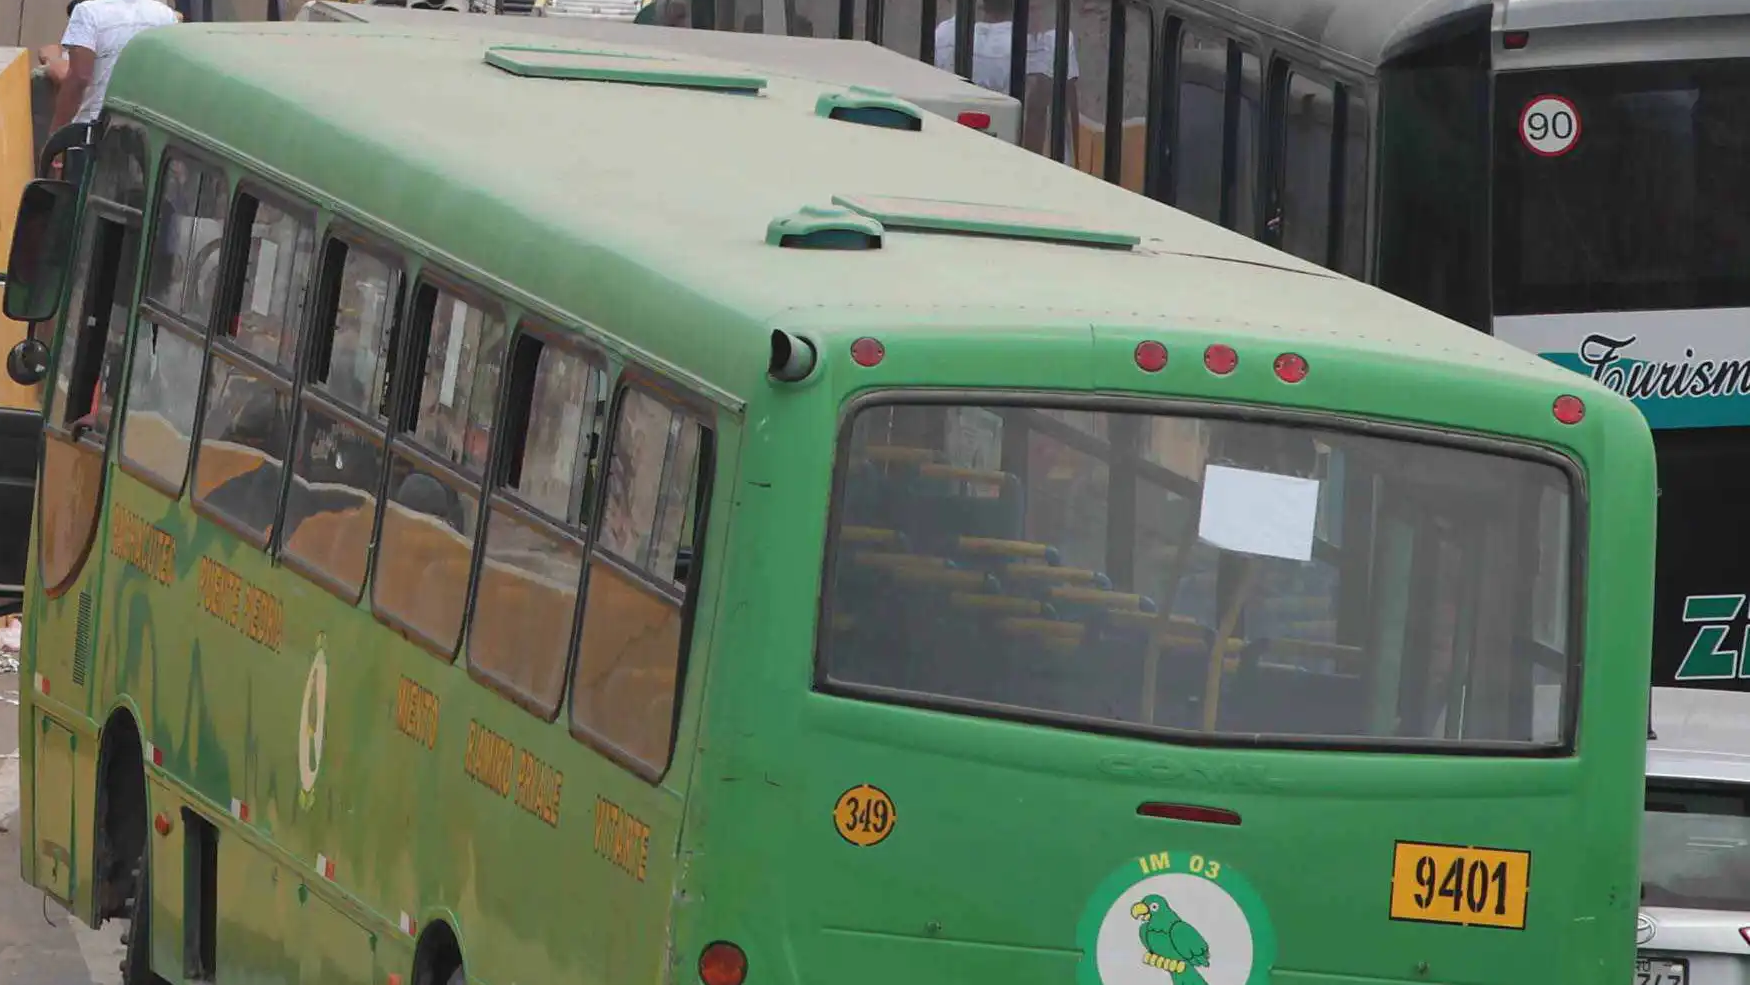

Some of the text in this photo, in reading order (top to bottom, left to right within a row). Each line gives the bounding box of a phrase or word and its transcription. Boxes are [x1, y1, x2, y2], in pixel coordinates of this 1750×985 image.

[1528, 111, 1573, 140] 90
[1675, 594, 1750, 681] Z
[845, 797, 889, 833] 349
[1139, 852, 1221, 878] IM 03
[1413, 855, 1508, 915] 9401
